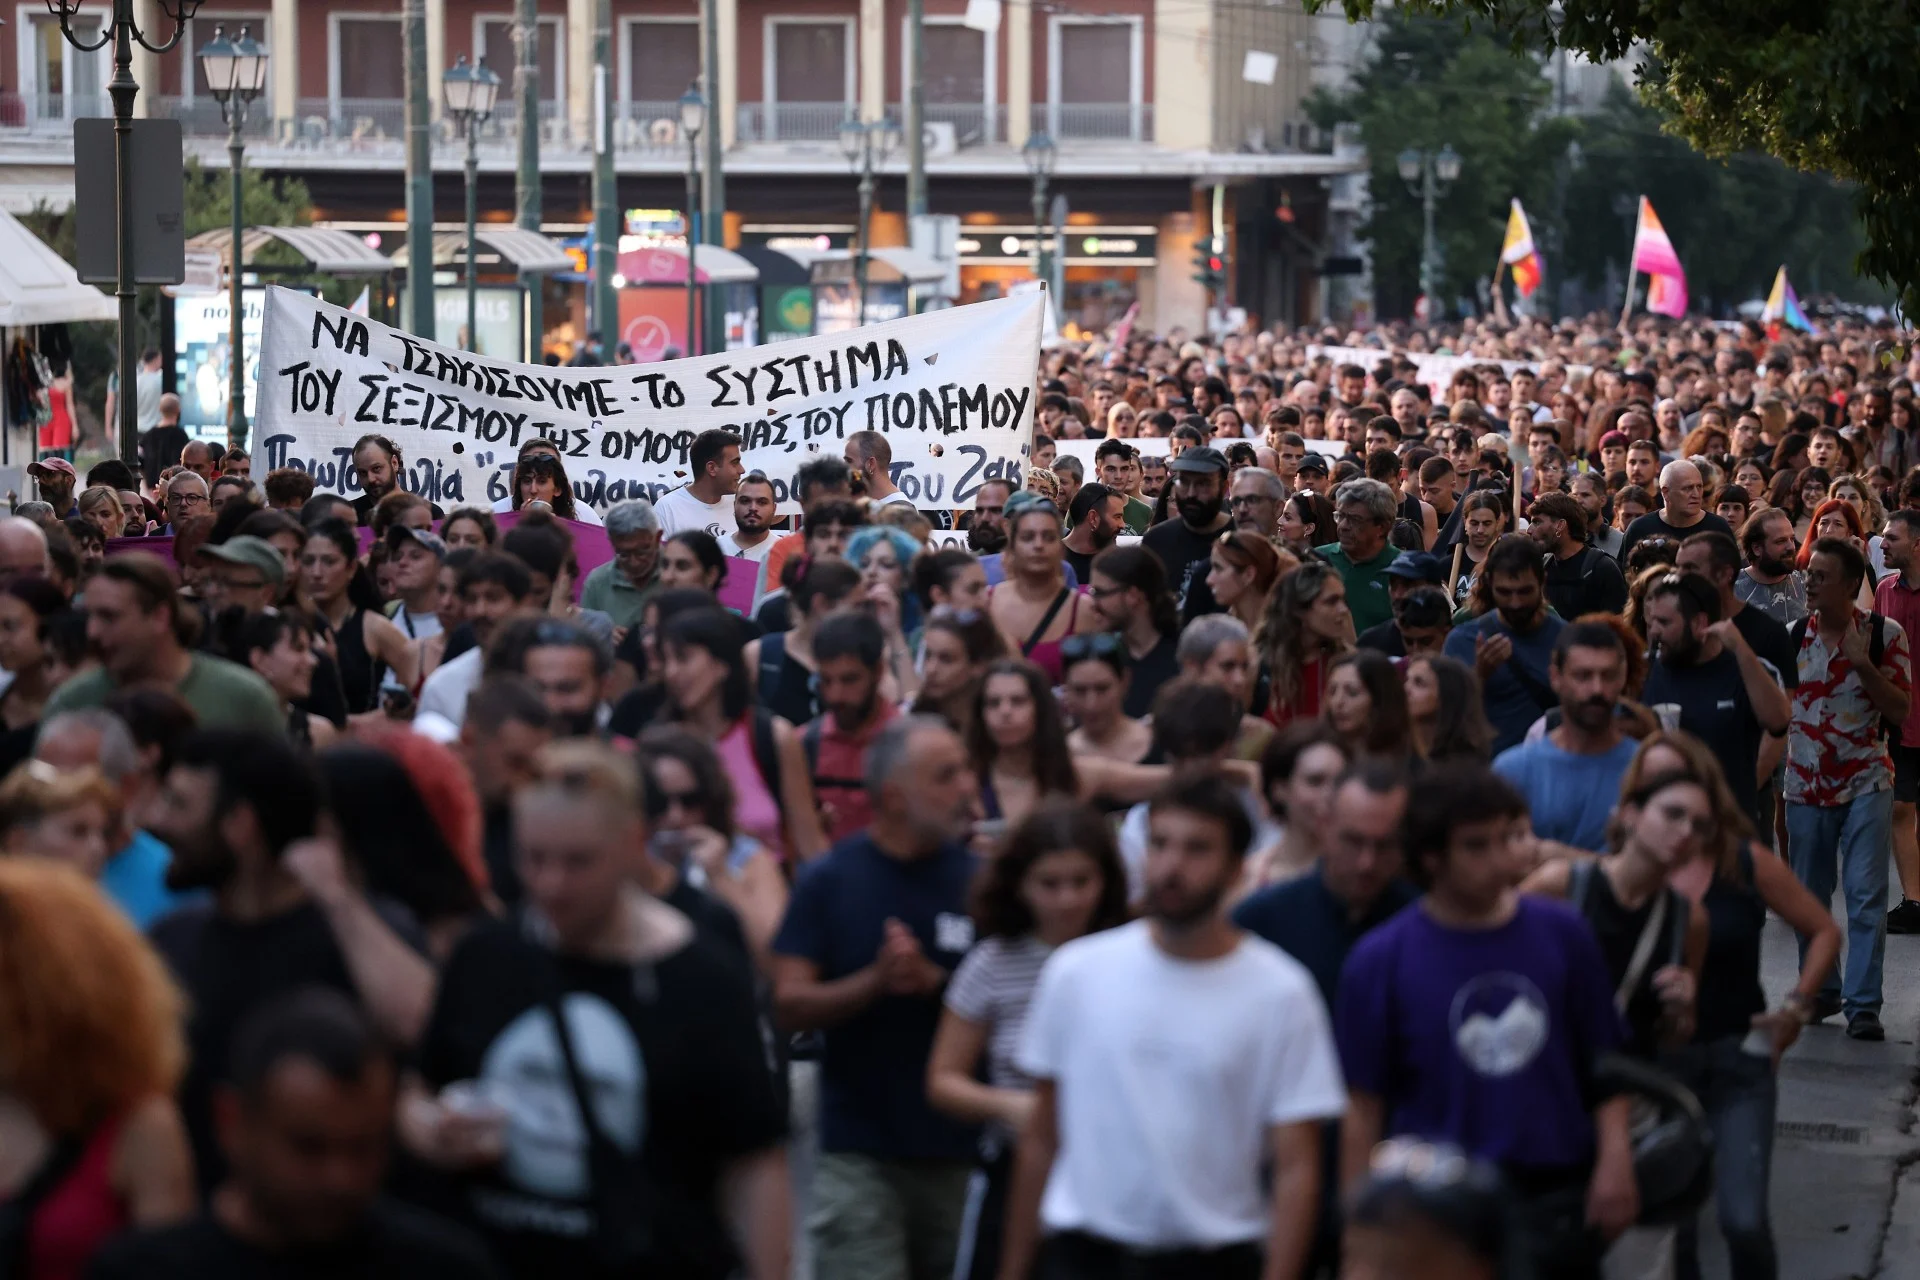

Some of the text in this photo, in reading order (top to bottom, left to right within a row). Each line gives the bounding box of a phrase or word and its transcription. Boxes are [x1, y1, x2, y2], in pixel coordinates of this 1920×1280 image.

[279, 361, 1030, 465] ΤΟΥ ΣΕΞΙΣΜΟΥ ΤΗΣ ΟΜΟΦΙΑΣ, ΤΟΥ ΠΟΛΕΜΟΥ
[312, 311, 909, 418] ΝΑ ΤΣΑΚΙΣΟΥΜΕ ΤΟ ΣΥΣΤΗΜΑ
